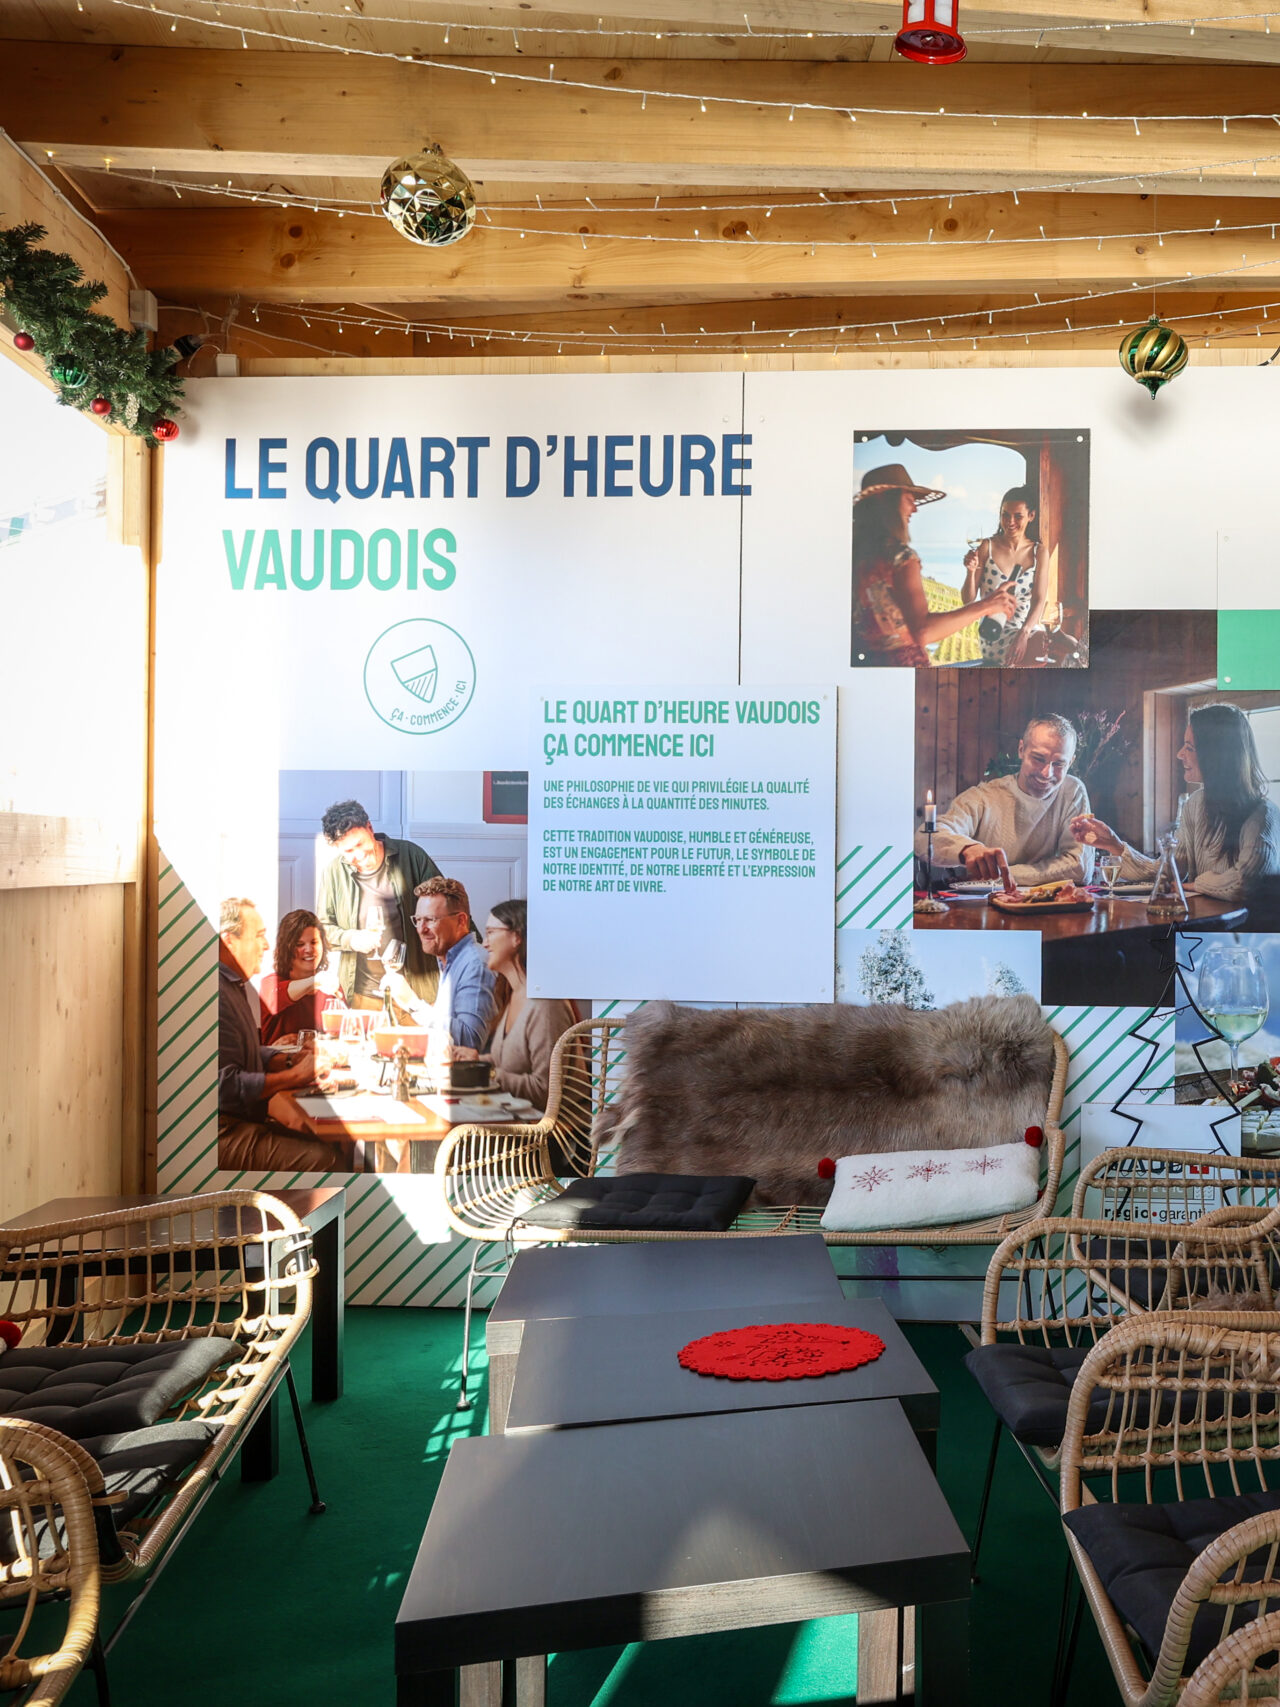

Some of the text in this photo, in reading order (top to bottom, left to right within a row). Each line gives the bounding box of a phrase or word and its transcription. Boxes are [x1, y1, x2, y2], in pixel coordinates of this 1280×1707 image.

[224, 433, 753, 504] LE QUART D’HEURE
[222, 527, 457, 592] VAUDOIS
[389, 680, 468, 726] ÇA COMMENCE ICI
[543, 700, 821, 725] LE QUART D’HEURE VAUDOIS
[543, 733, 715, 766] ÇA COMMENCE ICI
[543, 780, 565, 792] UNE
[566, 780, 635, 793] PHILOSOPHIE
[637, 780, 651, 793] DE
[653, 780, 670, 793] VIE
[671, 780, 689, 794] QUI
[691, 777, 749, 794] PRIVILÉGIE
[751, 781, 764, 794] LA
[766, 778, 810, 794] QUALITÉ
[543, 793, 770, 811] DES ÉCHANGES À LA QUANTITÉ DES MINUTES.
[543, 828, 814, 846] CETTE TRADITION VAUDOISE, HUMBLE ET GÉNÉREUSE,
[543, 846, 816, 862] EST UN ENGAGEMENT POUR LE FUTUR, LE SYMBOLE DE
[543, 860, 816, 878] NOTRE IDENTITÉ, DE NOTRE LIBERTÉ ET L’EXPRESSION
[543, 879, 667, 893] DE NOTRE ART DE VIVRE.
